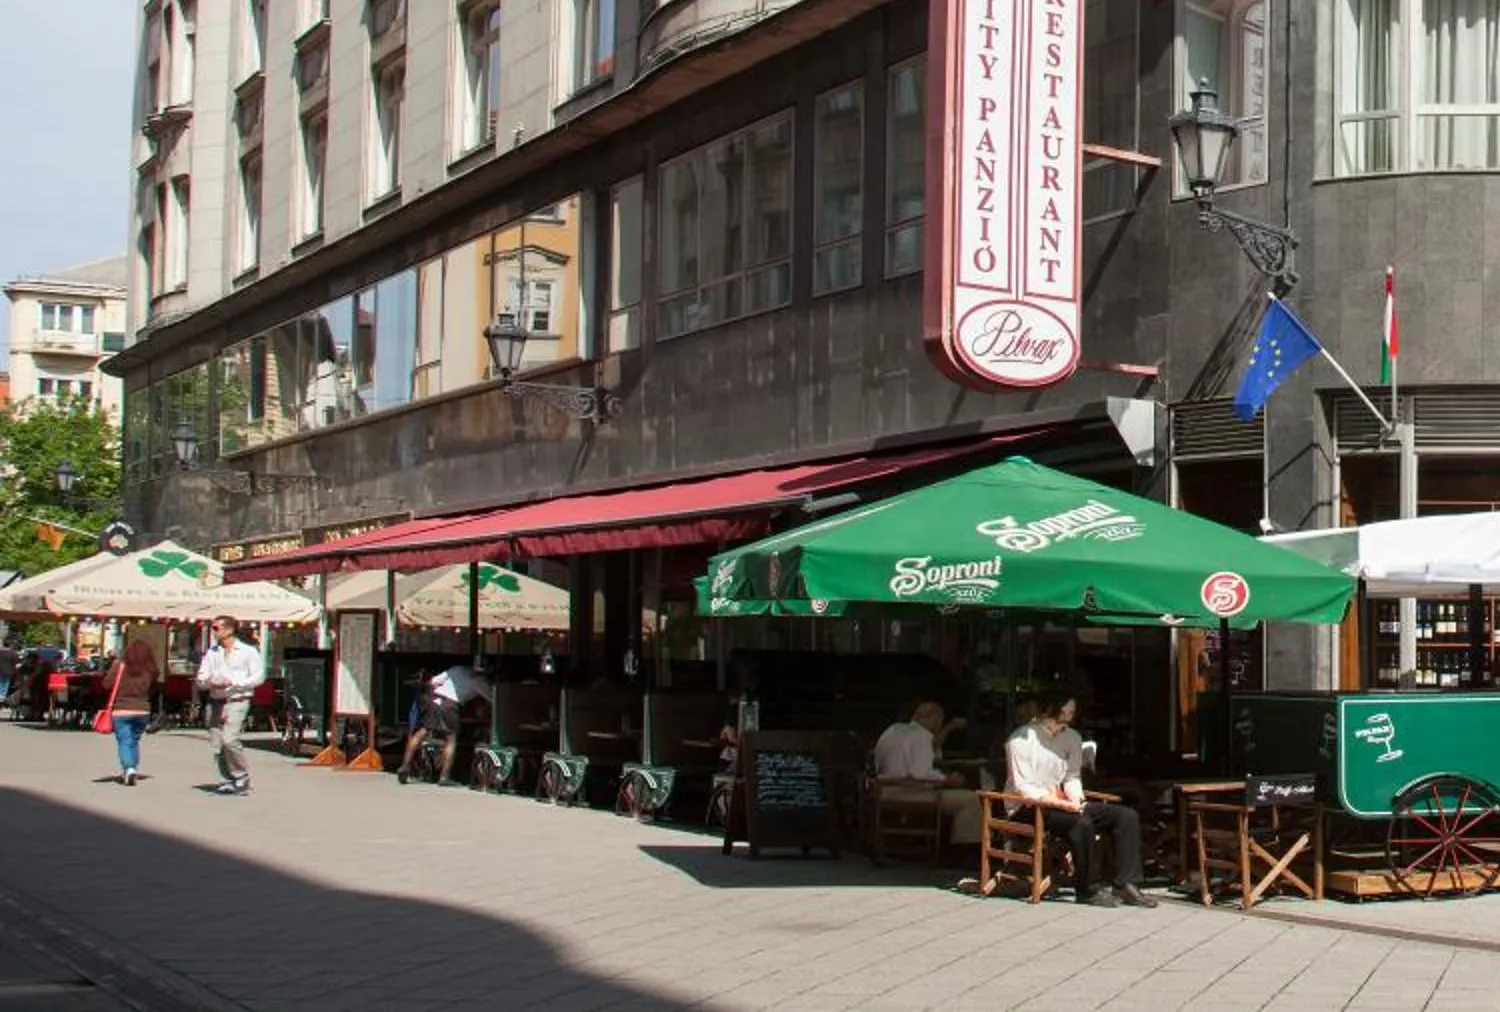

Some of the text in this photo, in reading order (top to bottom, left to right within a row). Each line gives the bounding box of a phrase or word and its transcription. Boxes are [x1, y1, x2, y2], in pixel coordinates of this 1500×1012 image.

[973, 97, 997, 273] PANZIÓ
[971, 309, 1065, 360] Pilvax
[976, 499, 1121, 553] Soproni
[890, 555, 1002, 597] Soproni
